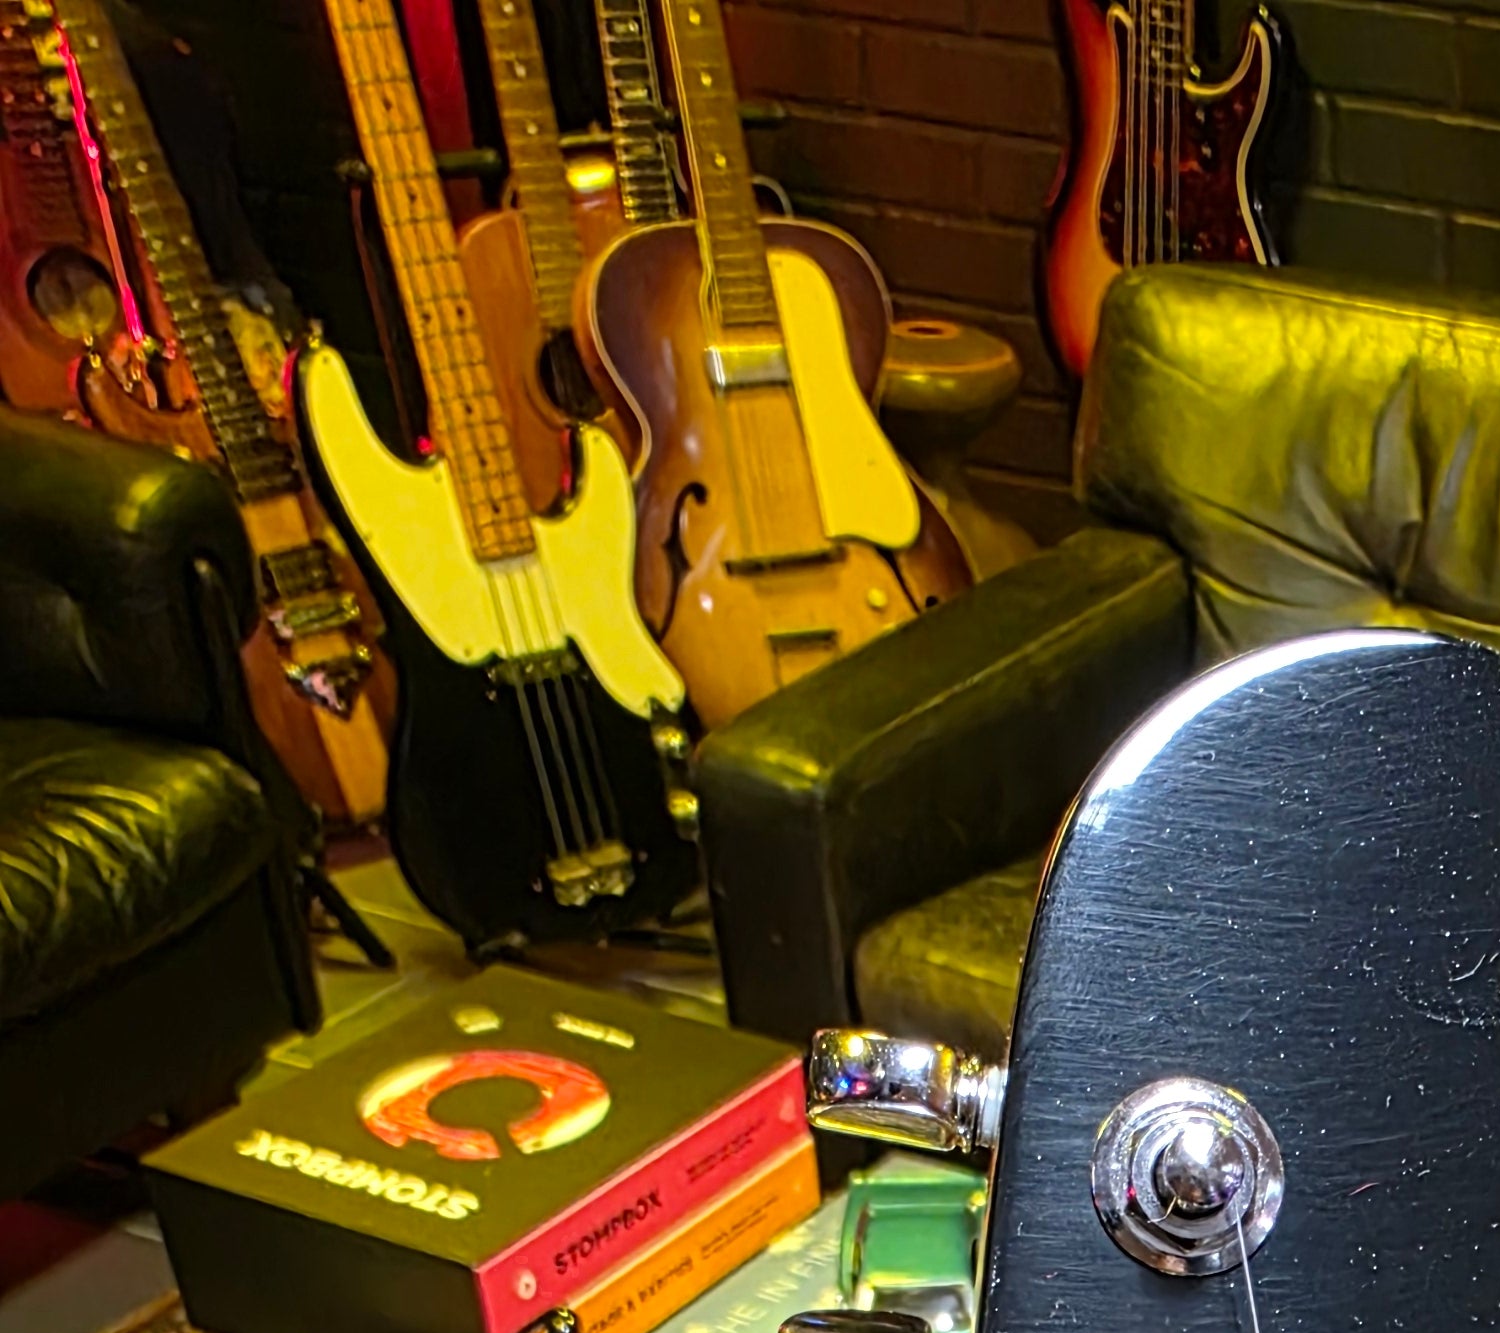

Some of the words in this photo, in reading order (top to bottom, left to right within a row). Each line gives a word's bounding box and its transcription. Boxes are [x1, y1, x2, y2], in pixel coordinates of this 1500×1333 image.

[236, 1129, 479, 1219] STOMPBOX
[554, 1188, 662, 1275] STOMPBOX
[755, 1276, 799, 1304] IN
